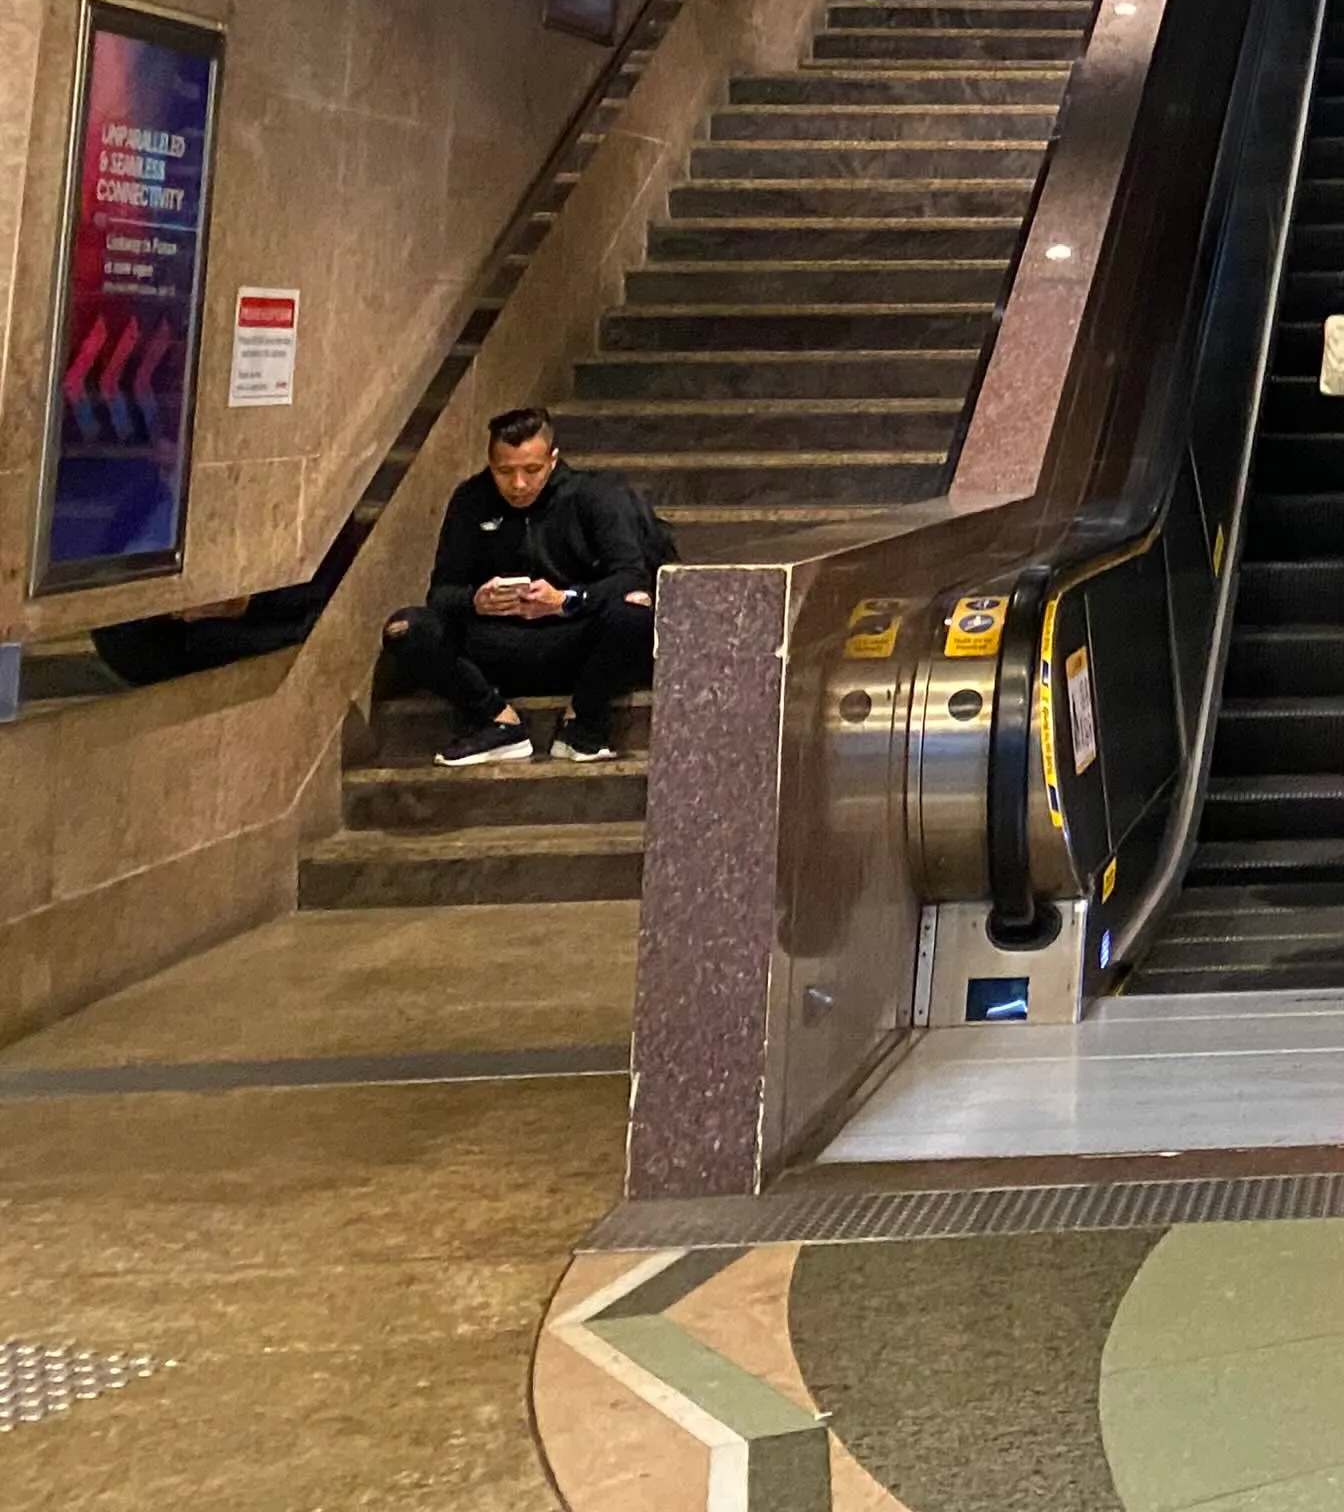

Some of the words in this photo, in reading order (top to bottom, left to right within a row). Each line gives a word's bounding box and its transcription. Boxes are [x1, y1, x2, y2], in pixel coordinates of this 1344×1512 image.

[102, 123, 186, 158] UNPARALLELED
[110, 152, 166, 180] SEAMLESS
[96, 178, 185, 213] CONNECTIVITY
